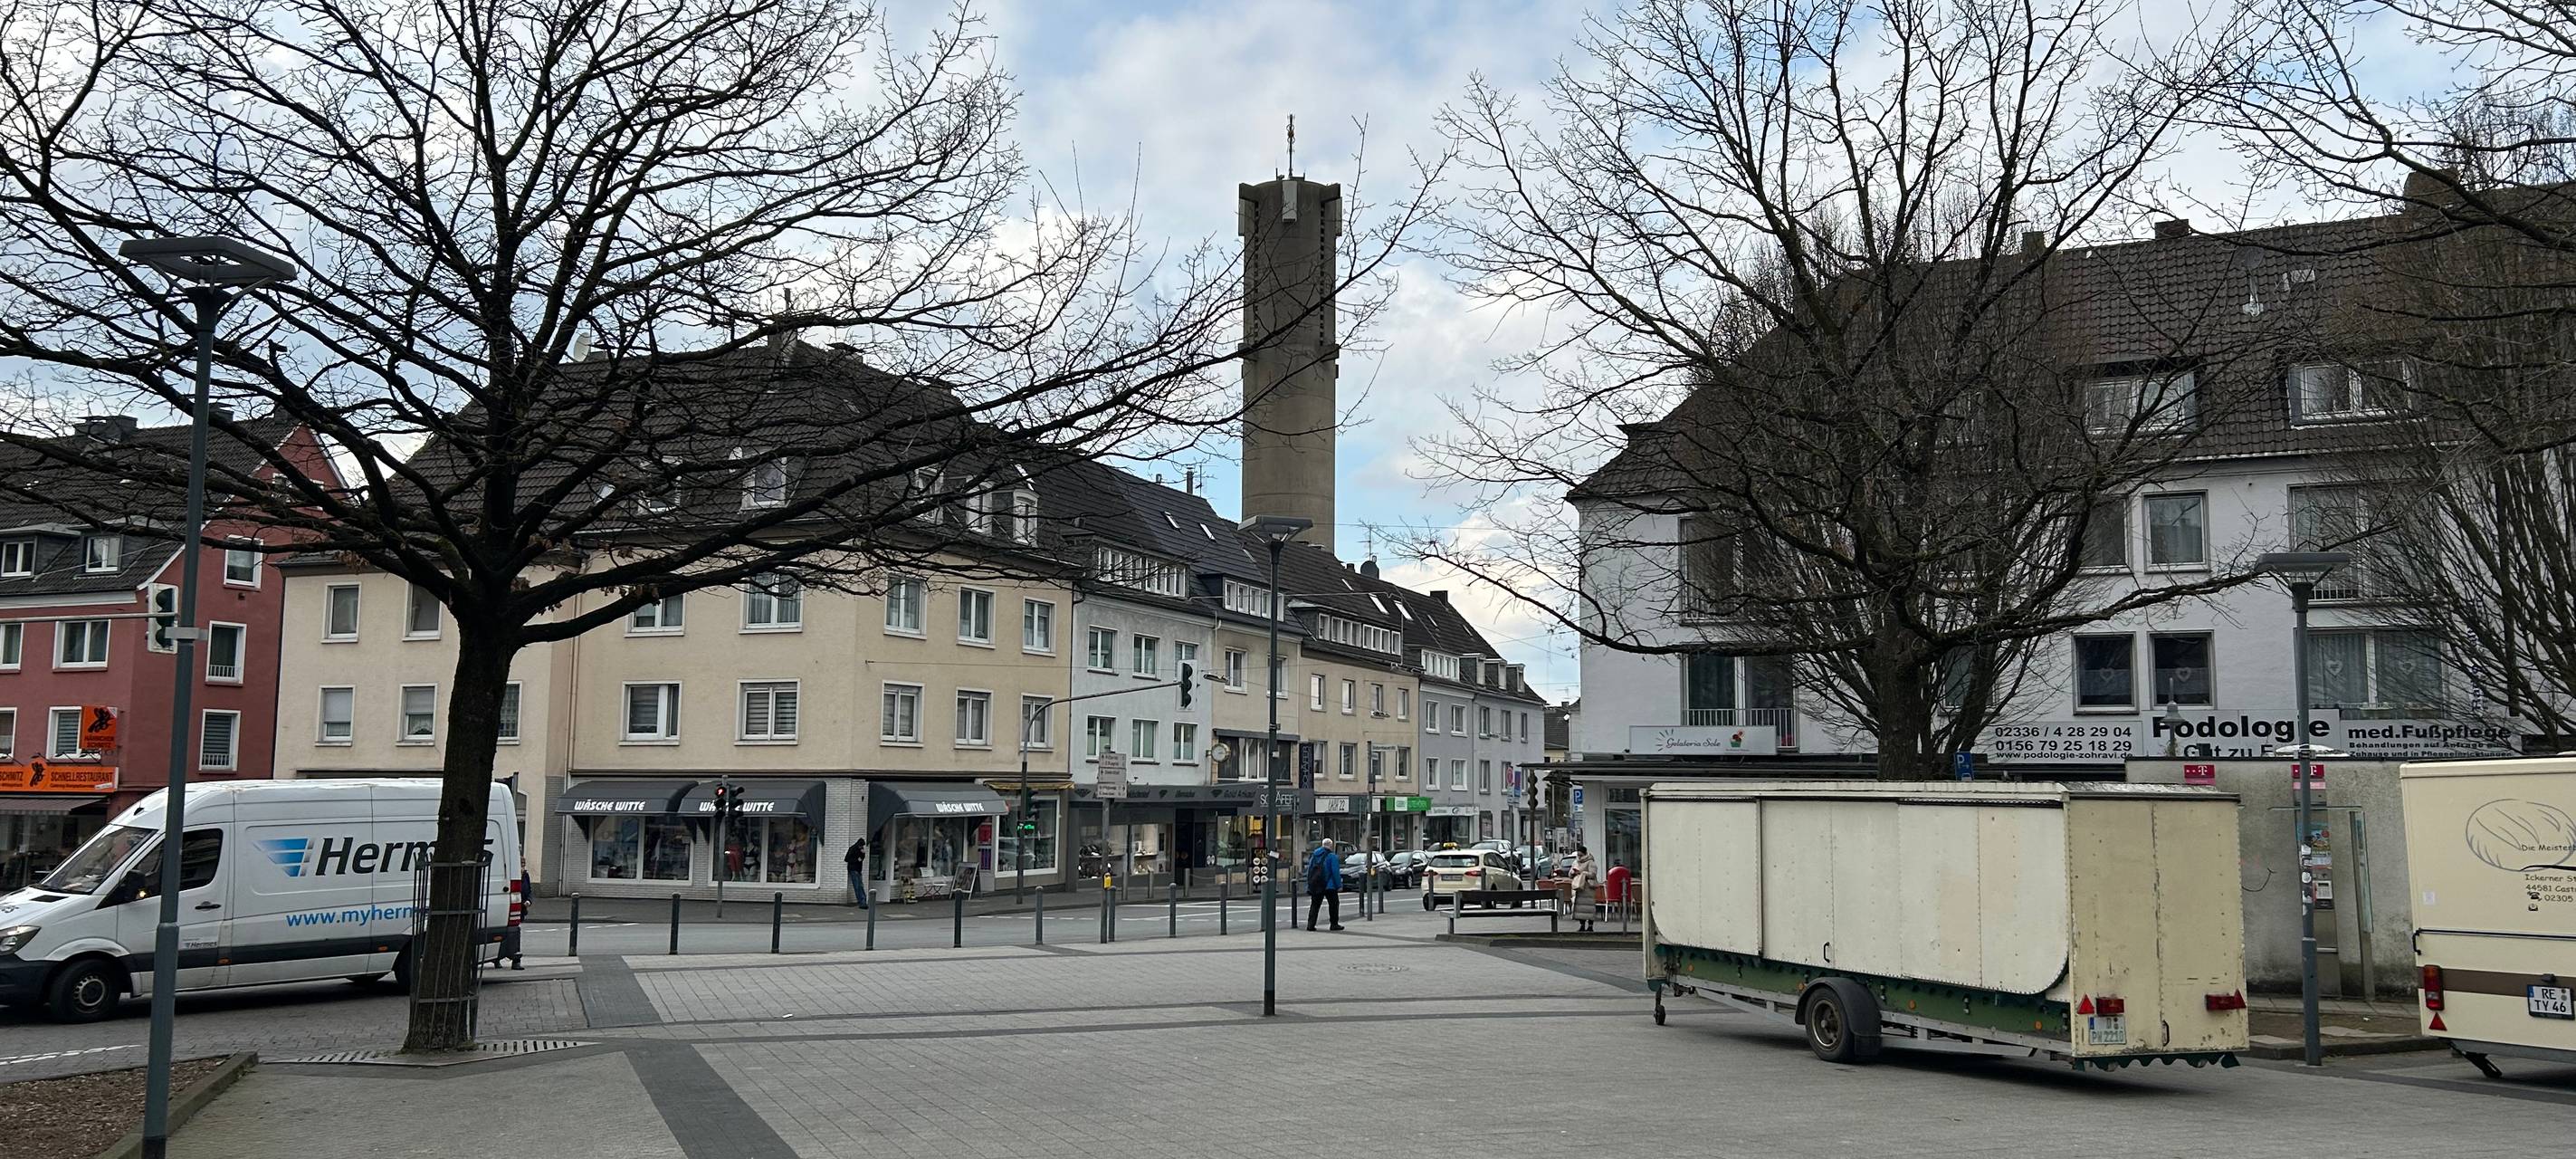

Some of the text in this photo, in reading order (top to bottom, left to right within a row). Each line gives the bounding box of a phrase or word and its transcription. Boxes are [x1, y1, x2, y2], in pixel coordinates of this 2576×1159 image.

[1995, 727, 2132, 737] 02336 / 4 28 29 04
[2152, 715, 2330, 742] Podologe
[2348, 725, 2512, 741] med.Fußpflege
[1665, 737, 1721, 748] Gelateria Sole
[1995, 741, 2132, 751] 0156 79 25 18 29
[1996, 752, 2133, 760] www.podologie-zohravi.de
[574, 799, 645, 811] WÄSCHE WITTE
[742, 801, 775, 811] WITTE
[935, 801, 985, 812] WÄSCHE WITTE
[2525, 874, 2564, 882] Ickerner
[2525, 884, 2552, 892] 44581
[2544, 895, 2573, 903] 02305
[2542, 988, 2556, 1000] RE
[2534, 1000, 2566, 1012] TY 46
